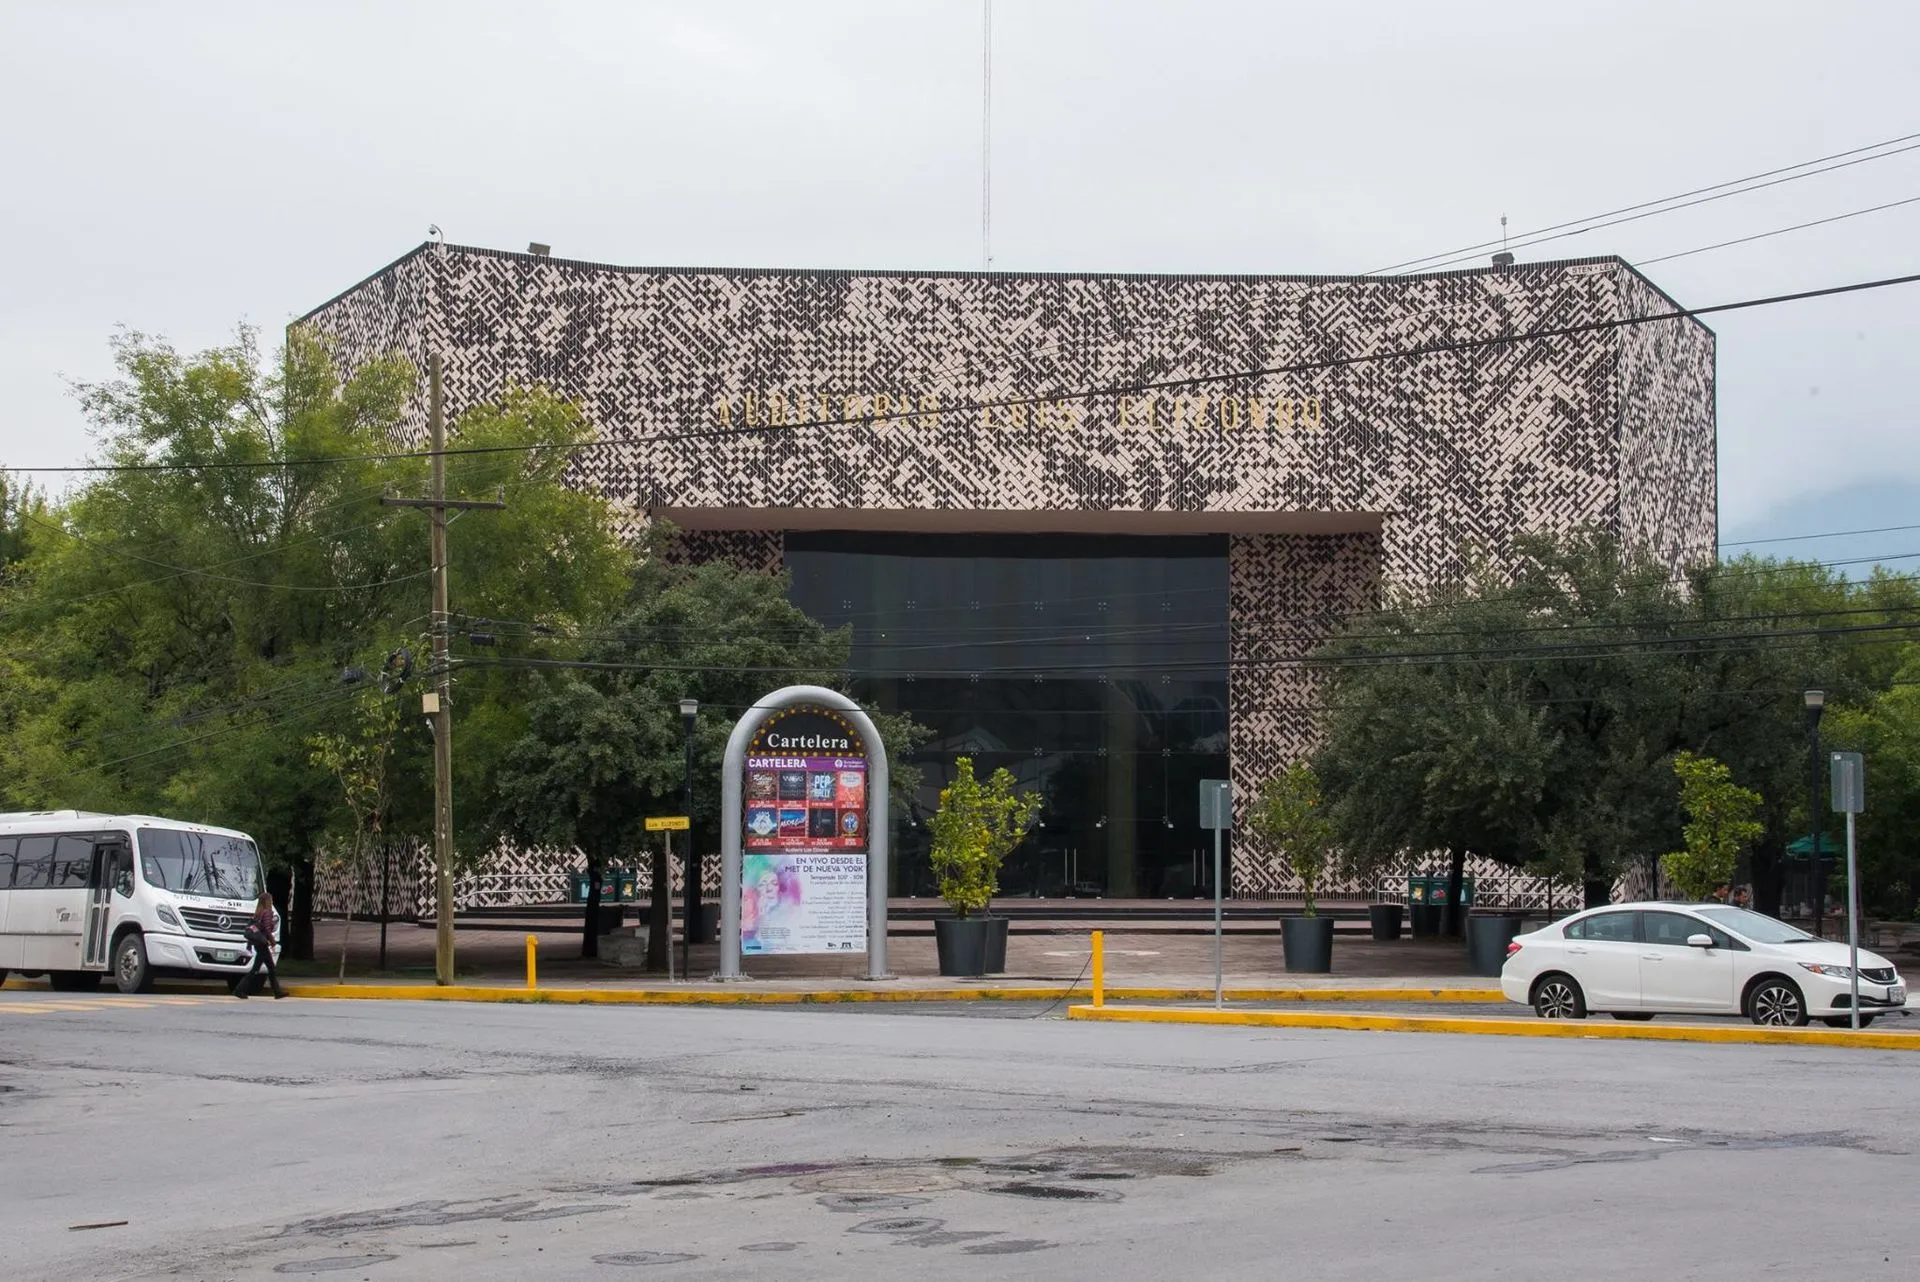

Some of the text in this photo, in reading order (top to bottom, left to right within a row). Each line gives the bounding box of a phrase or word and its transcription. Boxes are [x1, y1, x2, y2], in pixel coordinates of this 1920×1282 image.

[982, 395, 1076, 431] LUIS
[1118, 396, 1322, 431] ELIZONDO
[767, 733, 849, 749] Cartelera
[748, 758, 807, 768] CARTELERA
[796, 857, 864, 865] EN VIVO DESDE EL
[785, 865, 864, 873] MET DE NUEVA YORK
